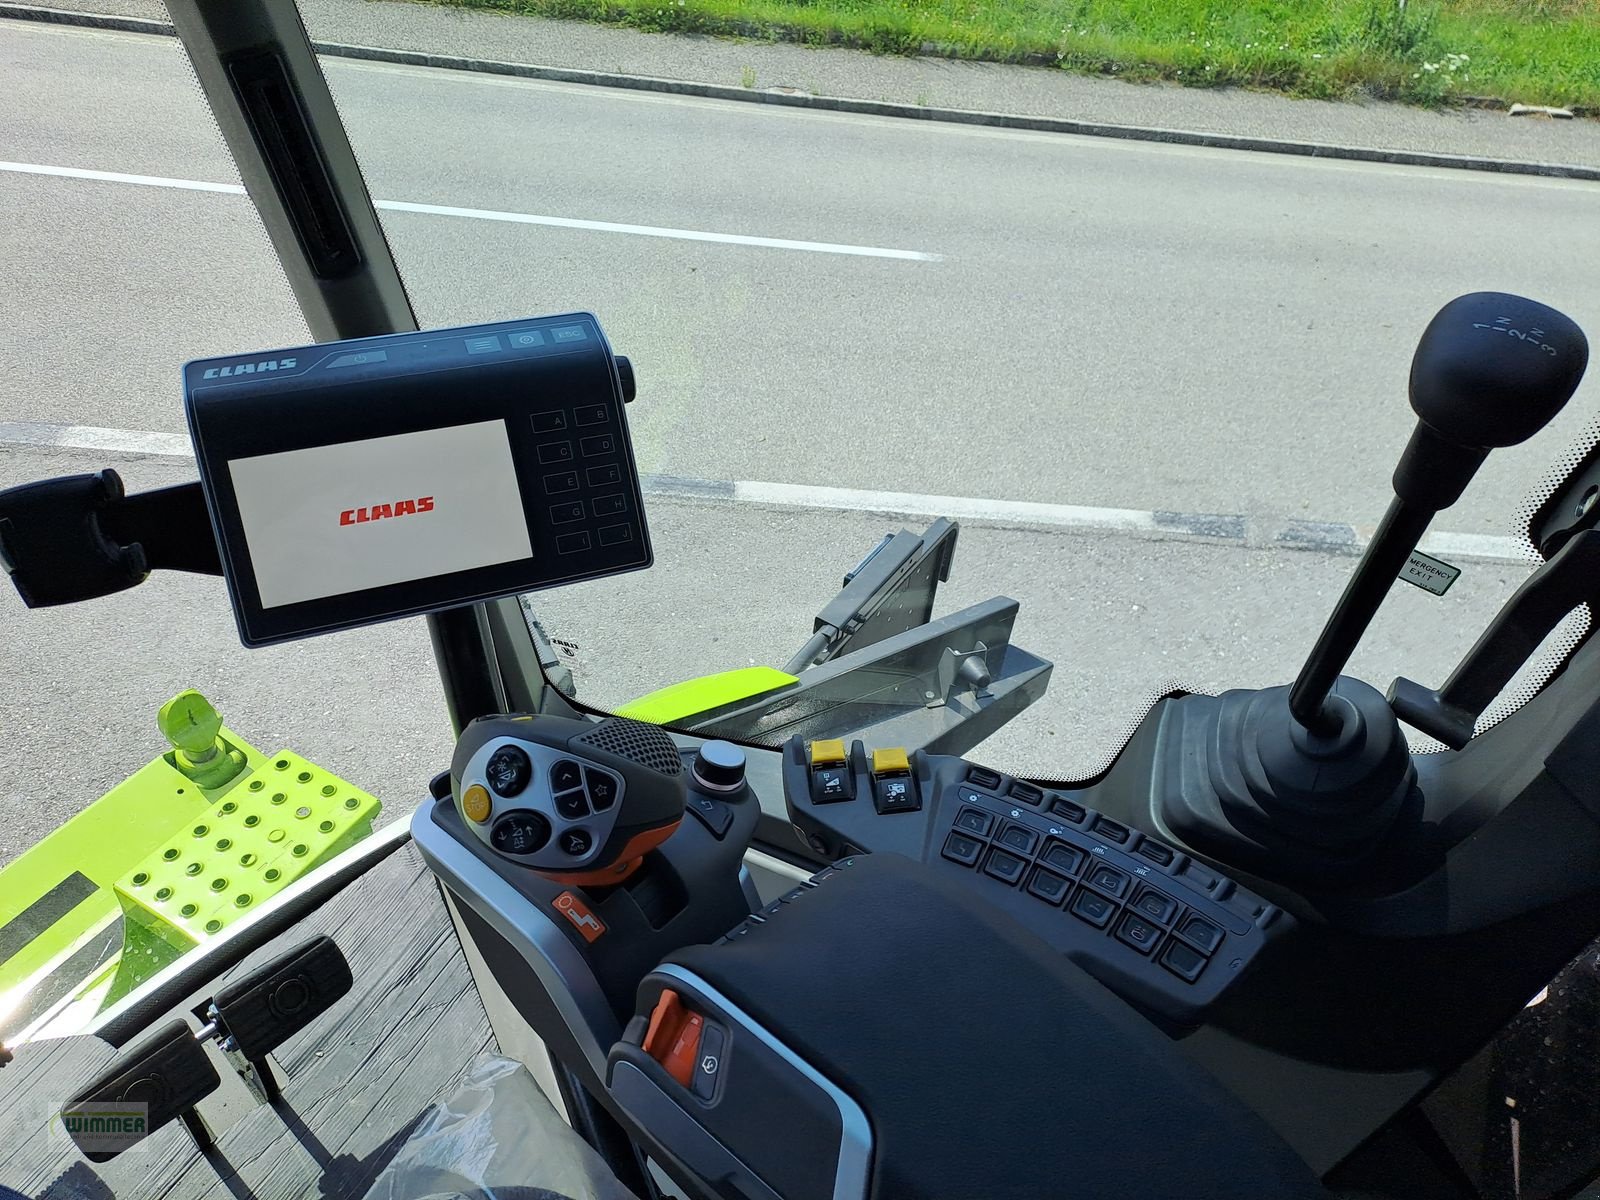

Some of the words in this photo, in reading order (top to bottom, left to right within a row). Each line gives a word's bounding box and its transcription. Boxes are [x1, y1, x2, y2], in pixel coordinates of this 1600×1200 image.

[558, 329, 580, 339] ESC
[203, 358, 297, 379] CLAAS
[555, 417, 563, 425] A
[602, 440, 610, 449] D
[560, 447, 568, 456] C
[609, 470, 616, 479] F
[567, 477, 575, 486] E
[339, 496, 434, 526] CLAAS
[1410, 557, 1452, 580] MERGENCY
[1409, 567, 1433, 581] EXIT
